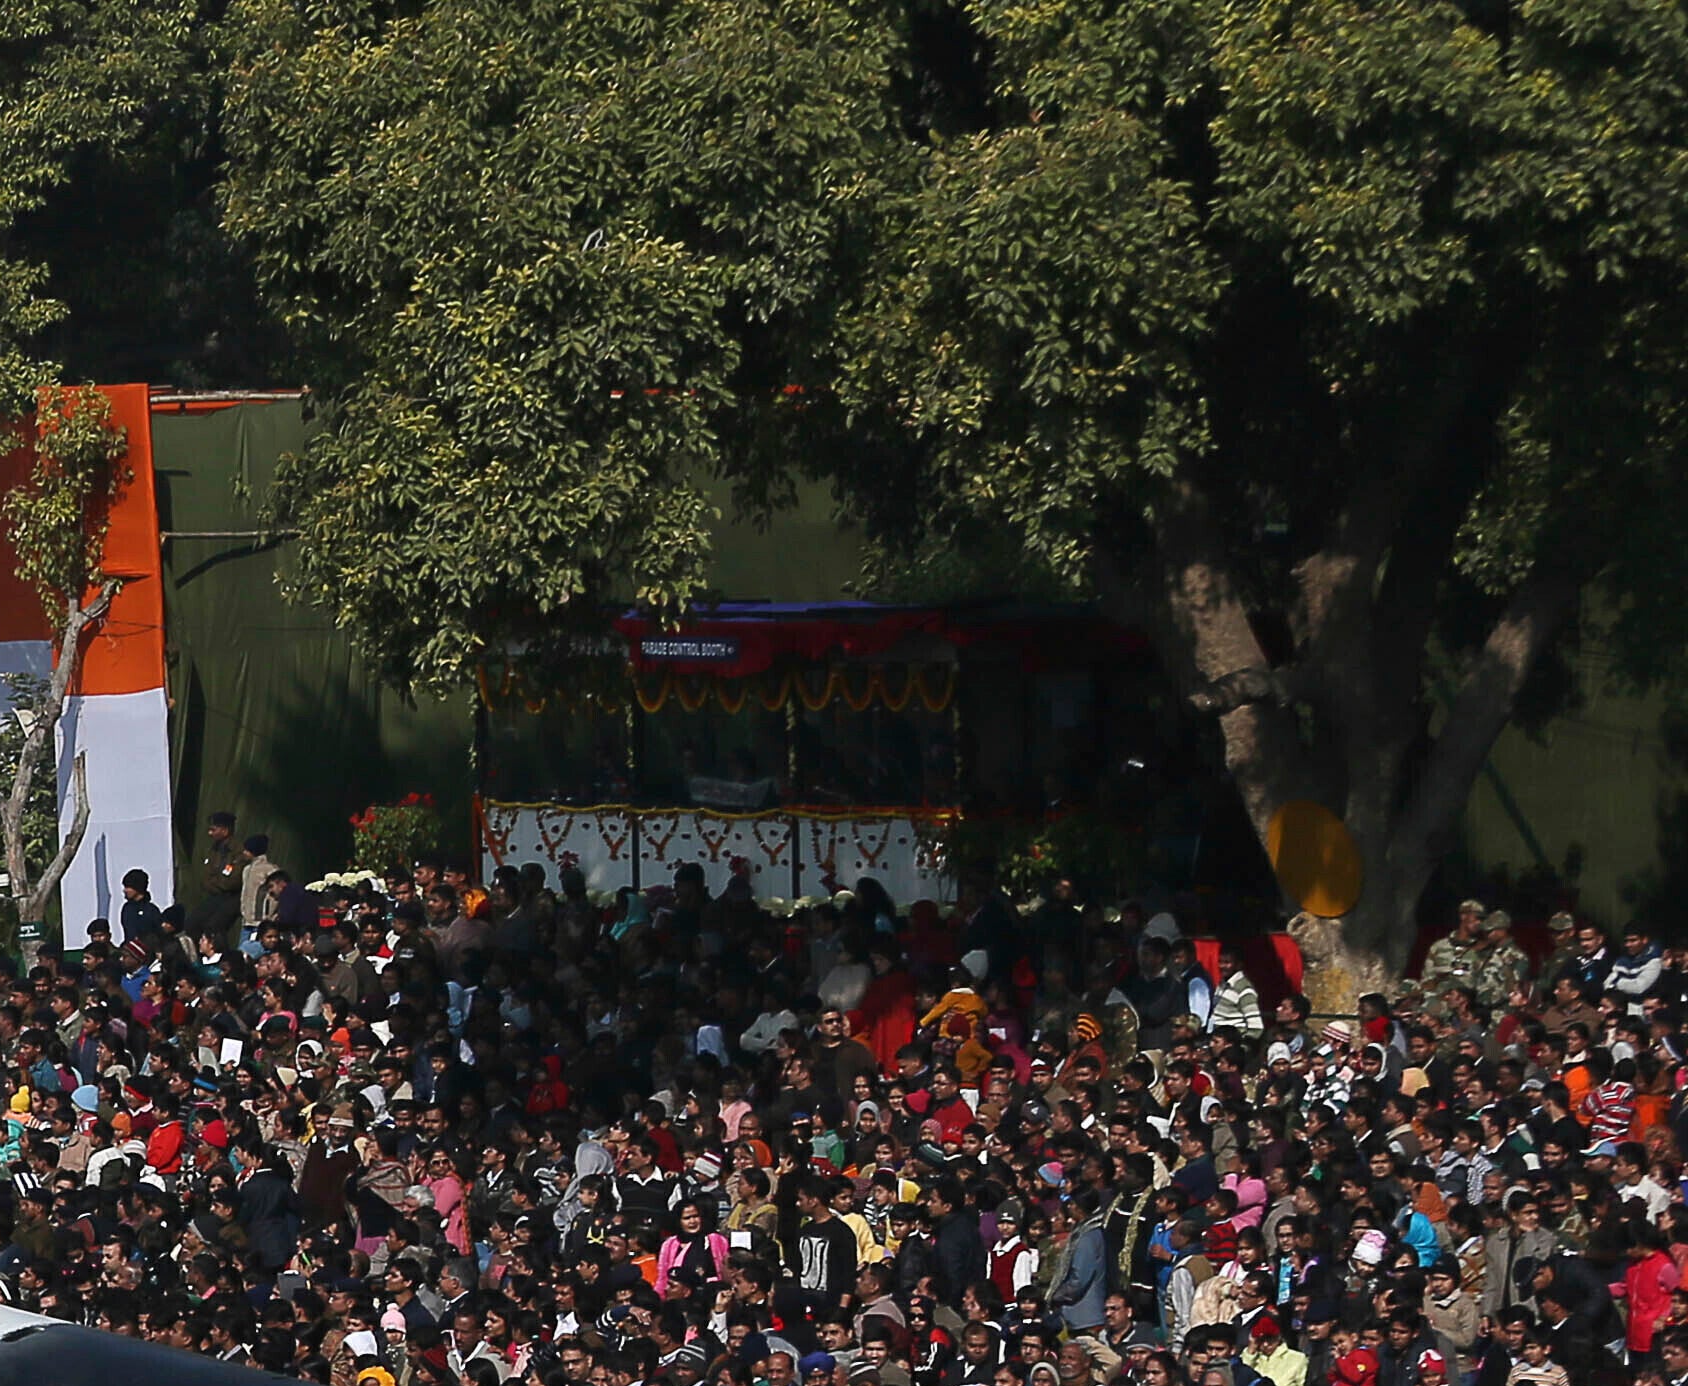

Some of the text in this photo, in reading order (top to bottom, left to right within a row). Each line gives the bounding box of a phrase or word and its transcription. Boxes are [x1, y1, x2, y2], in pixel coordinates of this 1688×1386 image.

[642, 642, 726, 656] PARADE CONTROL BOOTH
